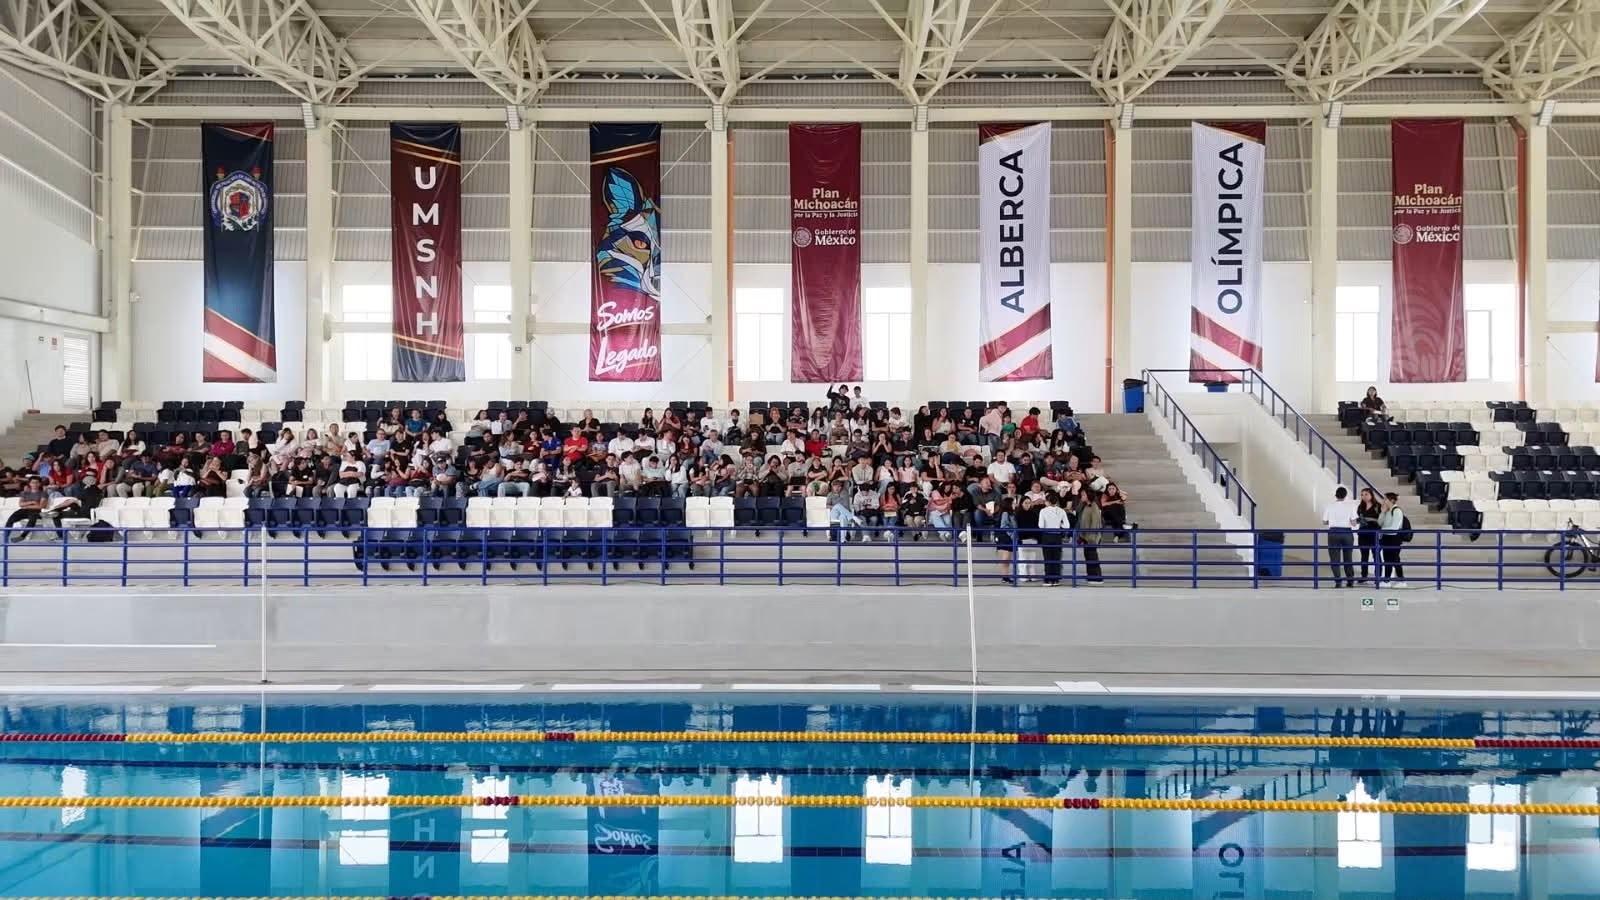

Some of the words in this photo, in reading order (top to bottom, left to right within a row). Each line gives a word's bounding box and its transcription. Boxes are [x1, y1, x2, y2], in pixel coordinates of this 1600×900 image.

[812, 187, 839, 198] Plan
[1414, 183, 1442, 194] Plan
[794, 197, 858, 209] Michoacán
[1394, 193, 1462, 205] Michoacán
[999, 149, 1024, 313] ALBERCA
[1211, 142, 1243, 314] OLÍMPICA
[814, 234, 856, 246] México
[1416, 231, 1460, 242] México
[412, 166, 439, 335] UMSNH
[596, 301, 654, 331] Somos
[595, 337, 658, 375] Legado
